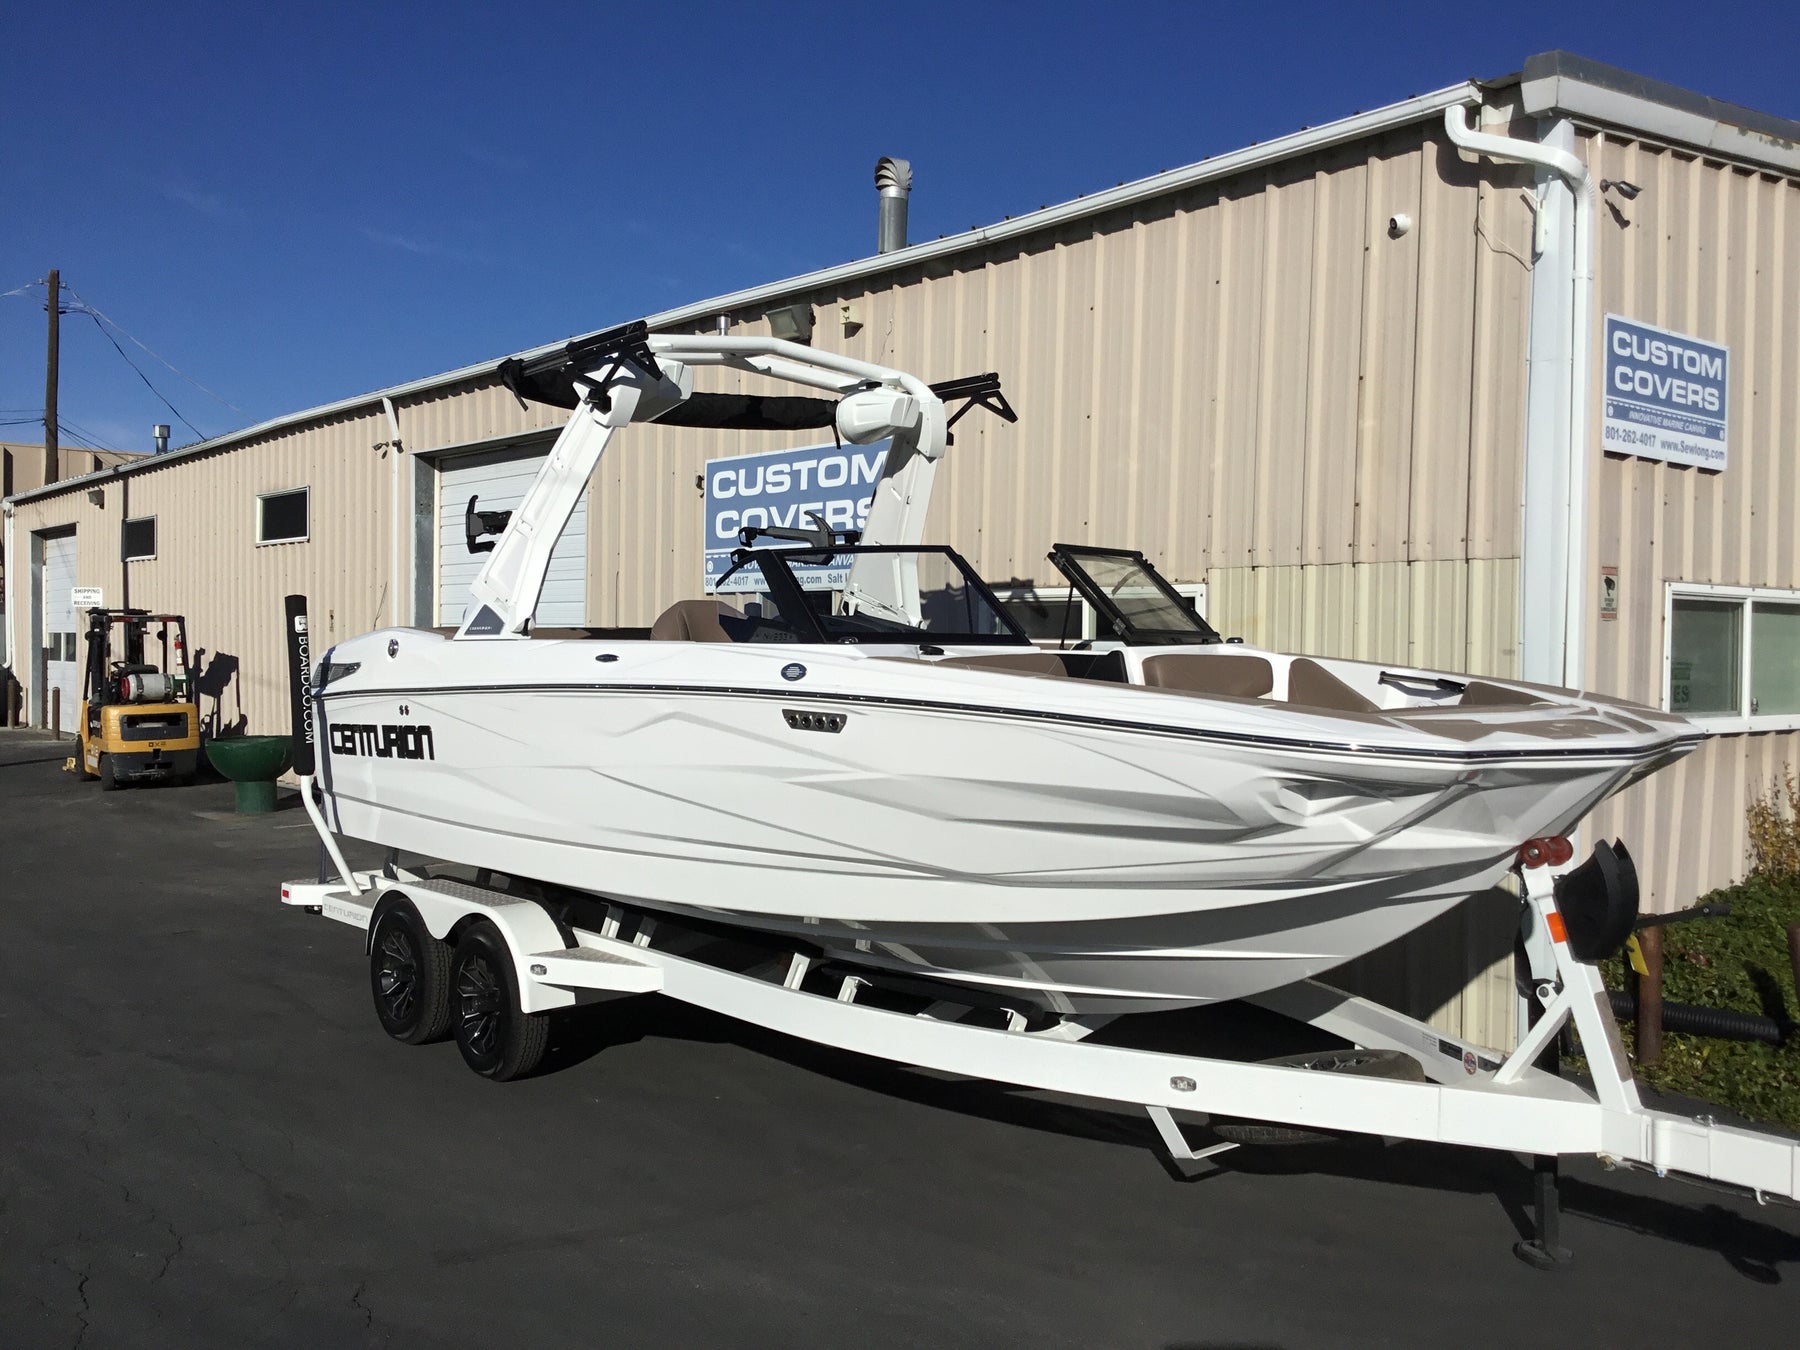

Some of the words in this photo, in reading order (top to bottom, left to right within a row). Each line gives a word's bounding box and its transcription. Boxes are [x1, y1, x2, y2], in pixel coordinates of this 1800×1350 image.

[1612, 330, 1722, 381] CUSTOM
[1614, 365, 1720, 411] COVERS
[1605, 425, 1656, 447] 801-262-4017
[1660, 439, 1725, 460] www.Sewlong.com
[1628, 411, 1662, 425] INNOVATIVE
[1662, 417, 1684, 430] MARINE
[1684, 422, 1707, 435] CANVAS
[712, 450, 889, 499] CUSTOM
[827, 573, 843, 584] Salt
[298, 636, 314, 744] BOARDCO.COM
[329, 723, 435, 761] CENTURION
